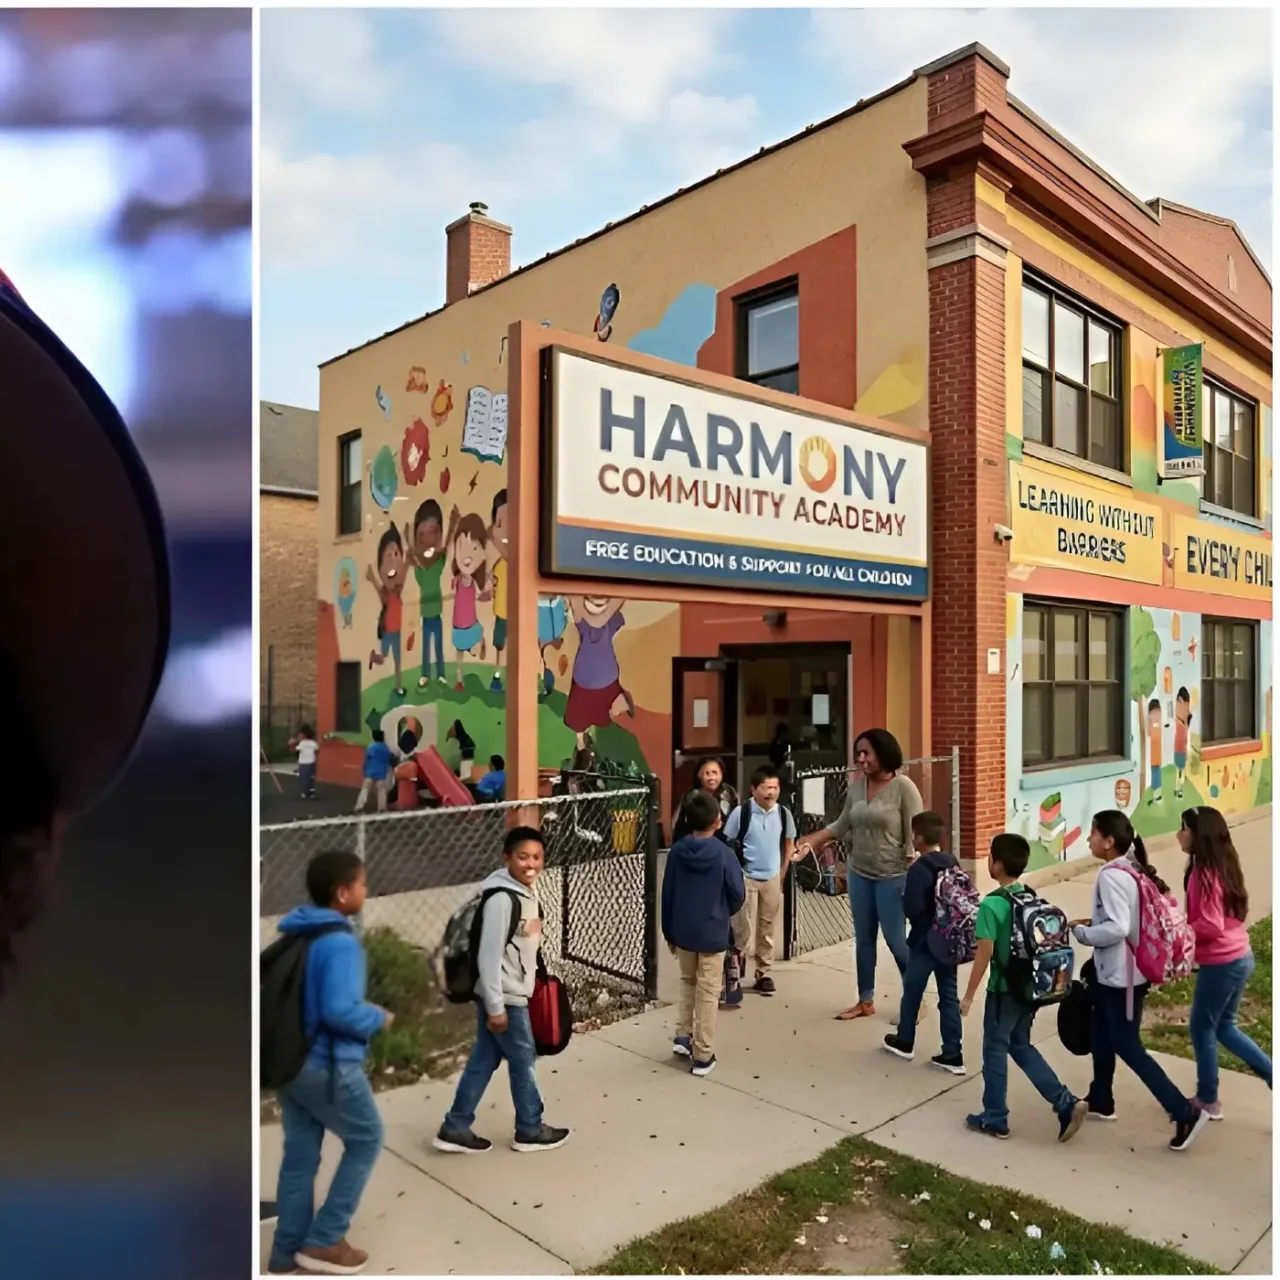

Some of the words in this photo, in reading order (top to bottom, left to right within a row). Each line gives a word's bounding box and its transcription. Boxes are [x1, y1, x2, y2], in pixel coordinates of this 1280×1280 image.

[599, 387, 907, 504] HARMONY
[598, 463, 786, 519] COMMUNITY
[793, 496, 907, 537] ACADEMY
